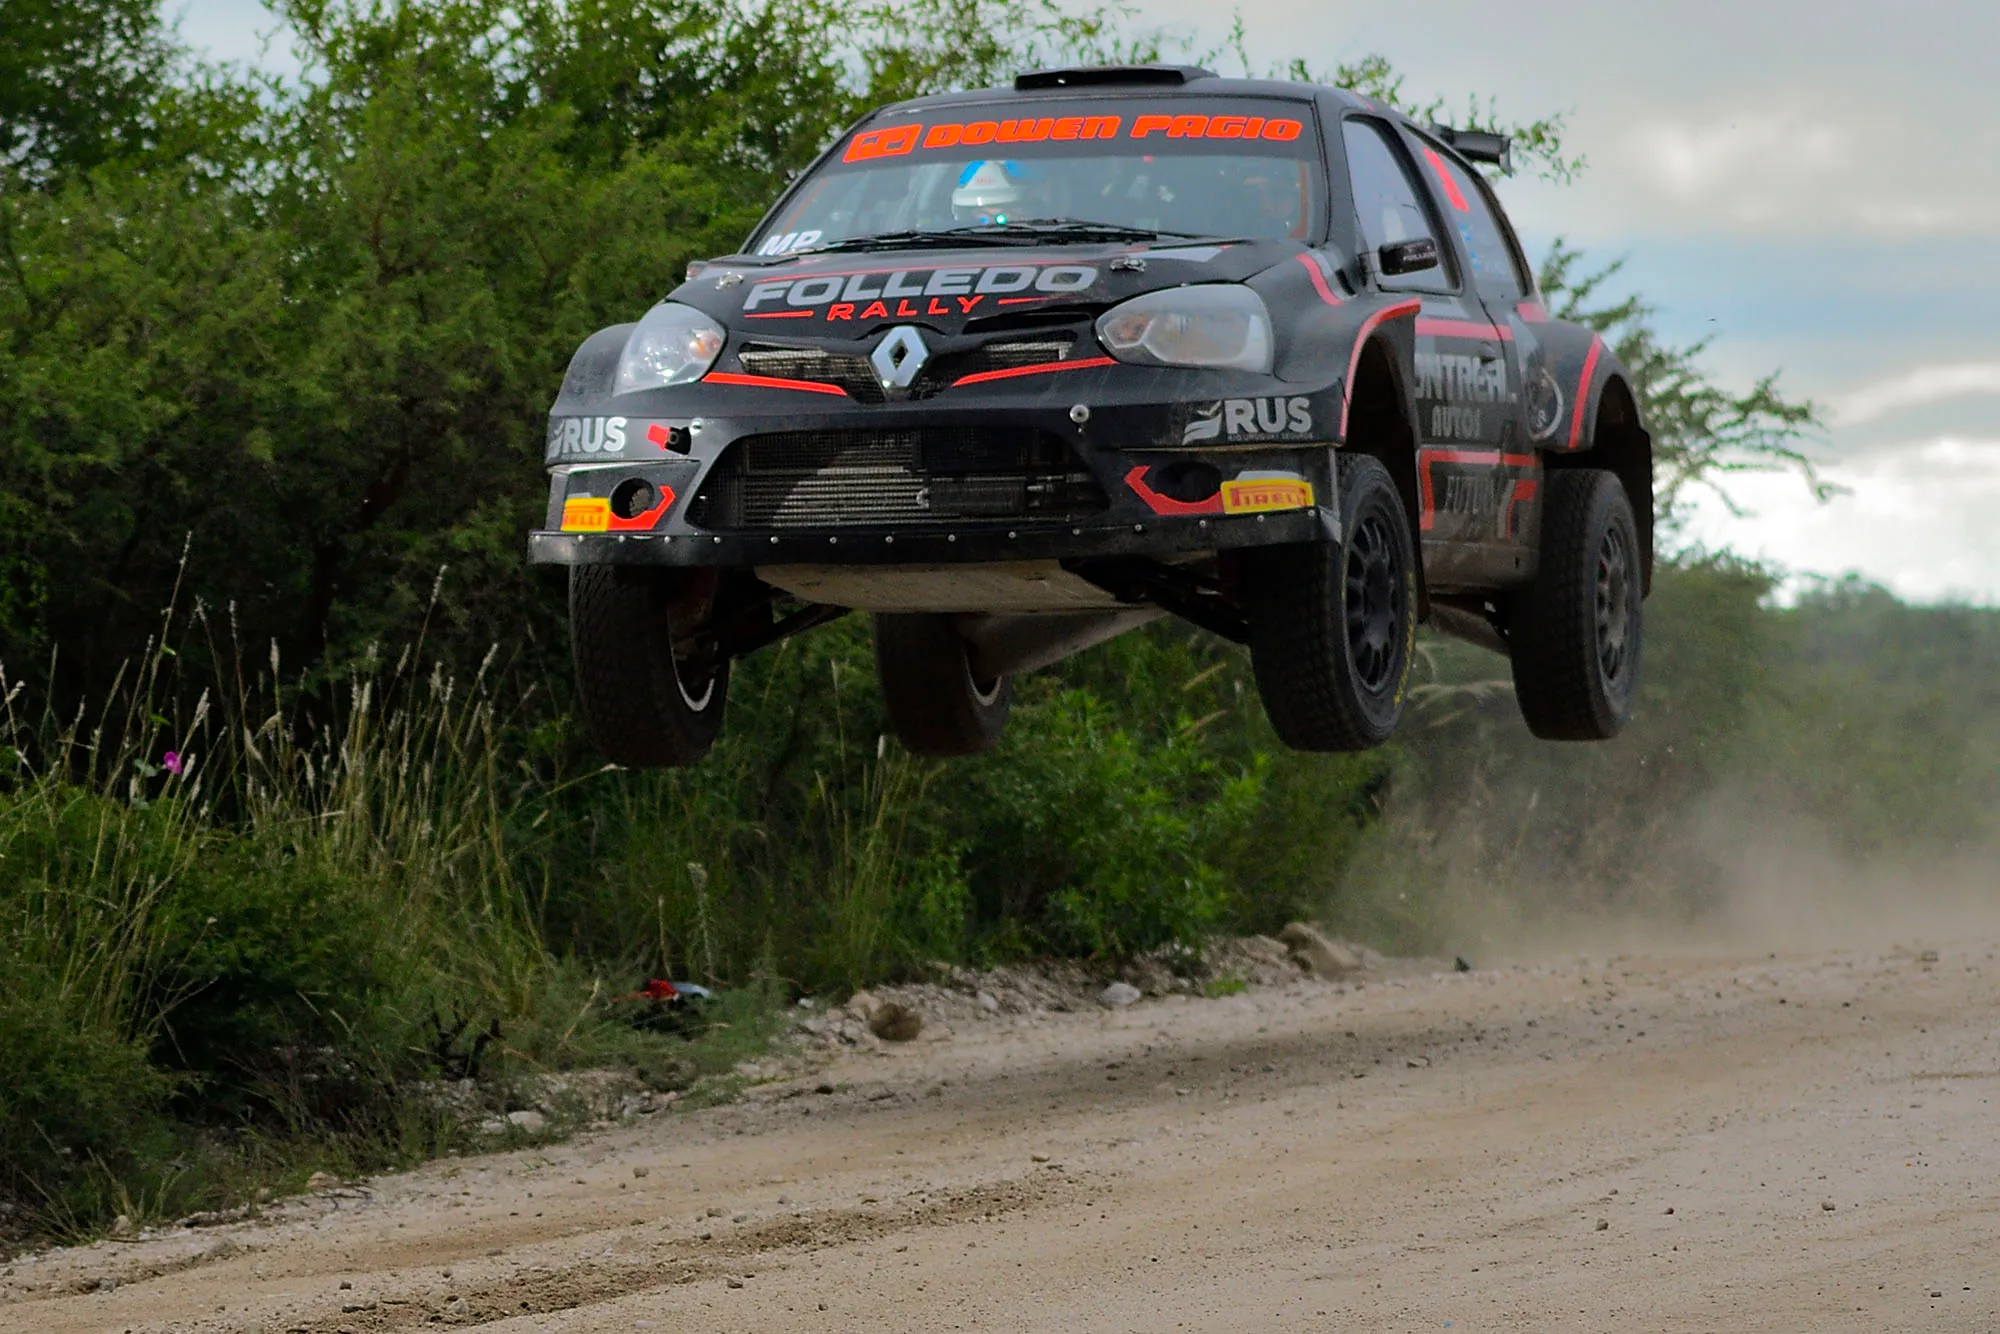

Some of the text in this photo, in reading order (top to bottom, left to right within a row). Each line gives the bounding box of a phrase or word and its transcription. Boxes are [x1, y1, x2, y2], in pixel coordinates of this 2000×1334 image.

[922, 114, 1304, 149] DOWEN PAGIO
[743, 264, 1099, 311] FOLLEDO
[826, 295, 984, 322] RALLY
[1224, 397, 1312, 434] RUS
[561, 416, 628, 454] RUS
